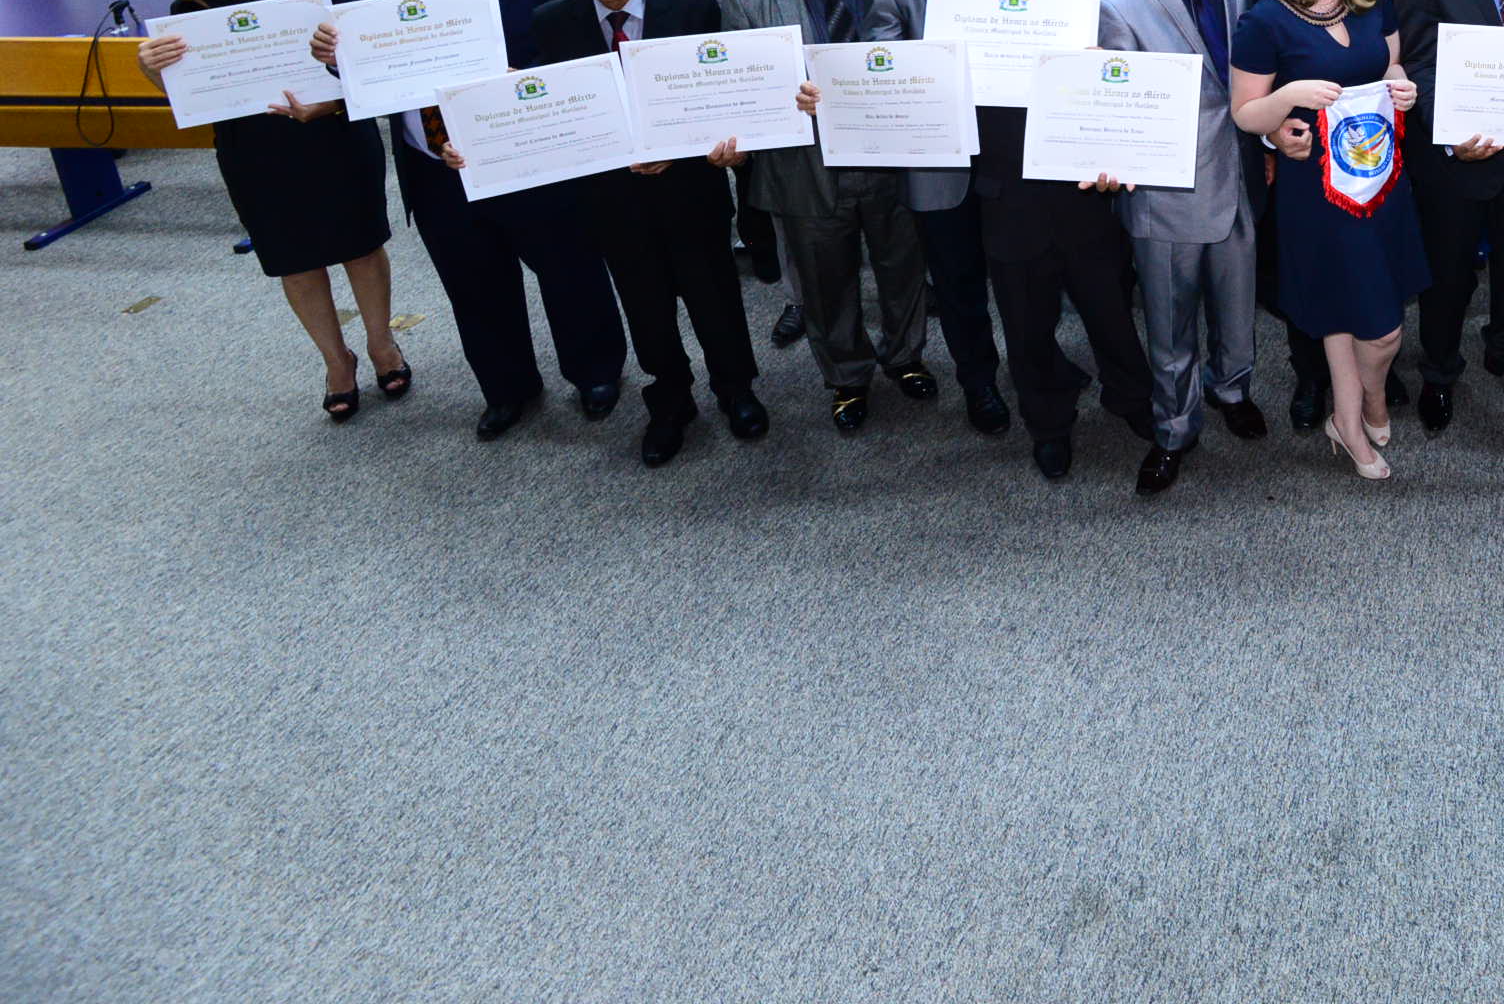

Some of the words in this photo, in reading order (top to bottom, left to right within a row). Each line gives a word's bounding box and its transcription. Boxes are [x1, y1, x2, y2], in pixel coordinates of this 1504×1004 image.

[360, 30, 392, 42] Diploma
[407, 25, 432, 34] Honra
[446, 17, 472, 28] Mérito
[1465, 61, 1496, 70] Diploma
[655, 73, 689, 83] Diploma
[705, 68, 731, 77] Honra
[747, 64, 774, 74] Mérito
[832, 78, 859, 87] Diploma
[873, 77, 895, 85] Honra
[1144, 91, 1170, 99] Mérito
[475, 110, 510, 122] Diploma
[526, 103, 552, 113] Honra
[568, 92, 596, 105] Mérito
